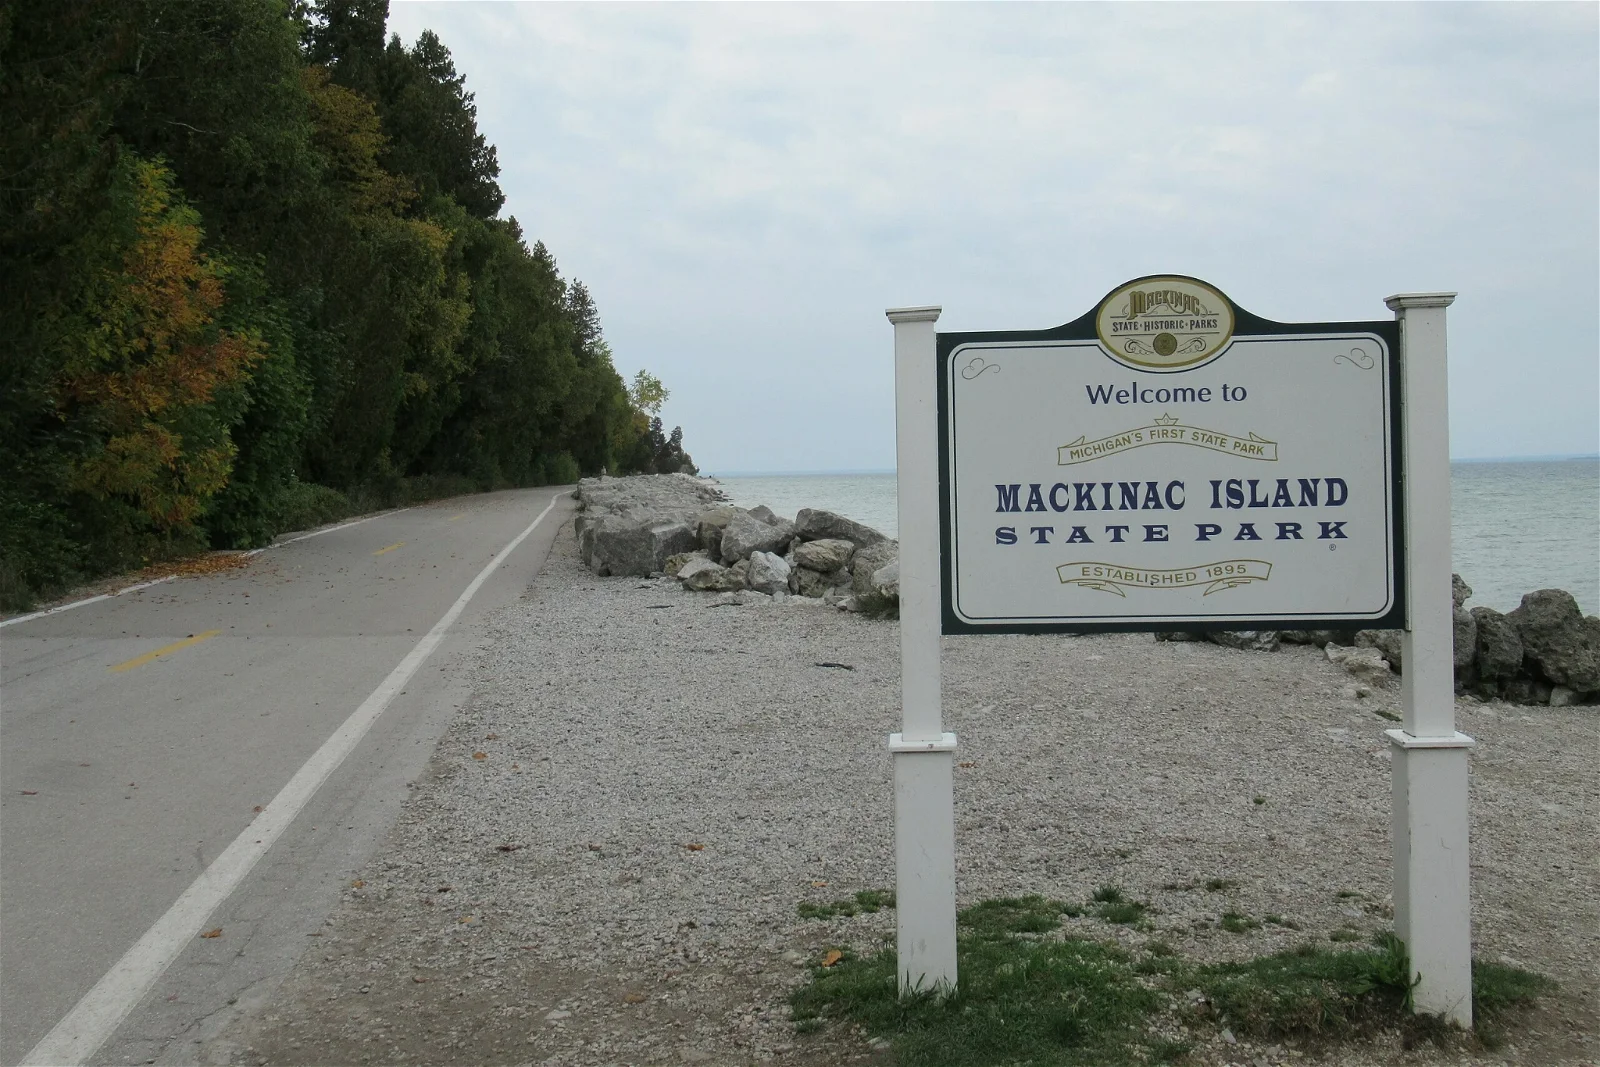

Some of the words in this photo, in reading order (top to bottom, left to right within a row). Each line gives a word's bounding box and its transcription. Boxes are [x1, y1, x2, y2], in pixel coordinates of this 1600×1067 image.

[1126, 289, 1200, 320] MACKINAC
[1112, 321, 1139, 332] STATE
[1144, 319, 1184, 331] HISTORIC
[1189, 318, 1218, 330] PARKS
[1086, 381, 1212, 404] Welcome
[1221, 383, 1248, 402] to
[1069, 432, 1143, 460] MICHIGAN'S
[1149, 429, 1186, 440] FIRST
[1191, 431, 1228, 448] STATE
[1233, 441, 1265, 456] PARK
[994, 480, 1186, 513] MACKINAC
[1209, 477, 1349, 510] ISLAND
[995, 524, 1169, 546] STATE
[1194, 521, 1349, 542] PARK
[1081, 566, 1197, 584] ESTABLISHED
[1205, 564, 1247, 578] 1895
